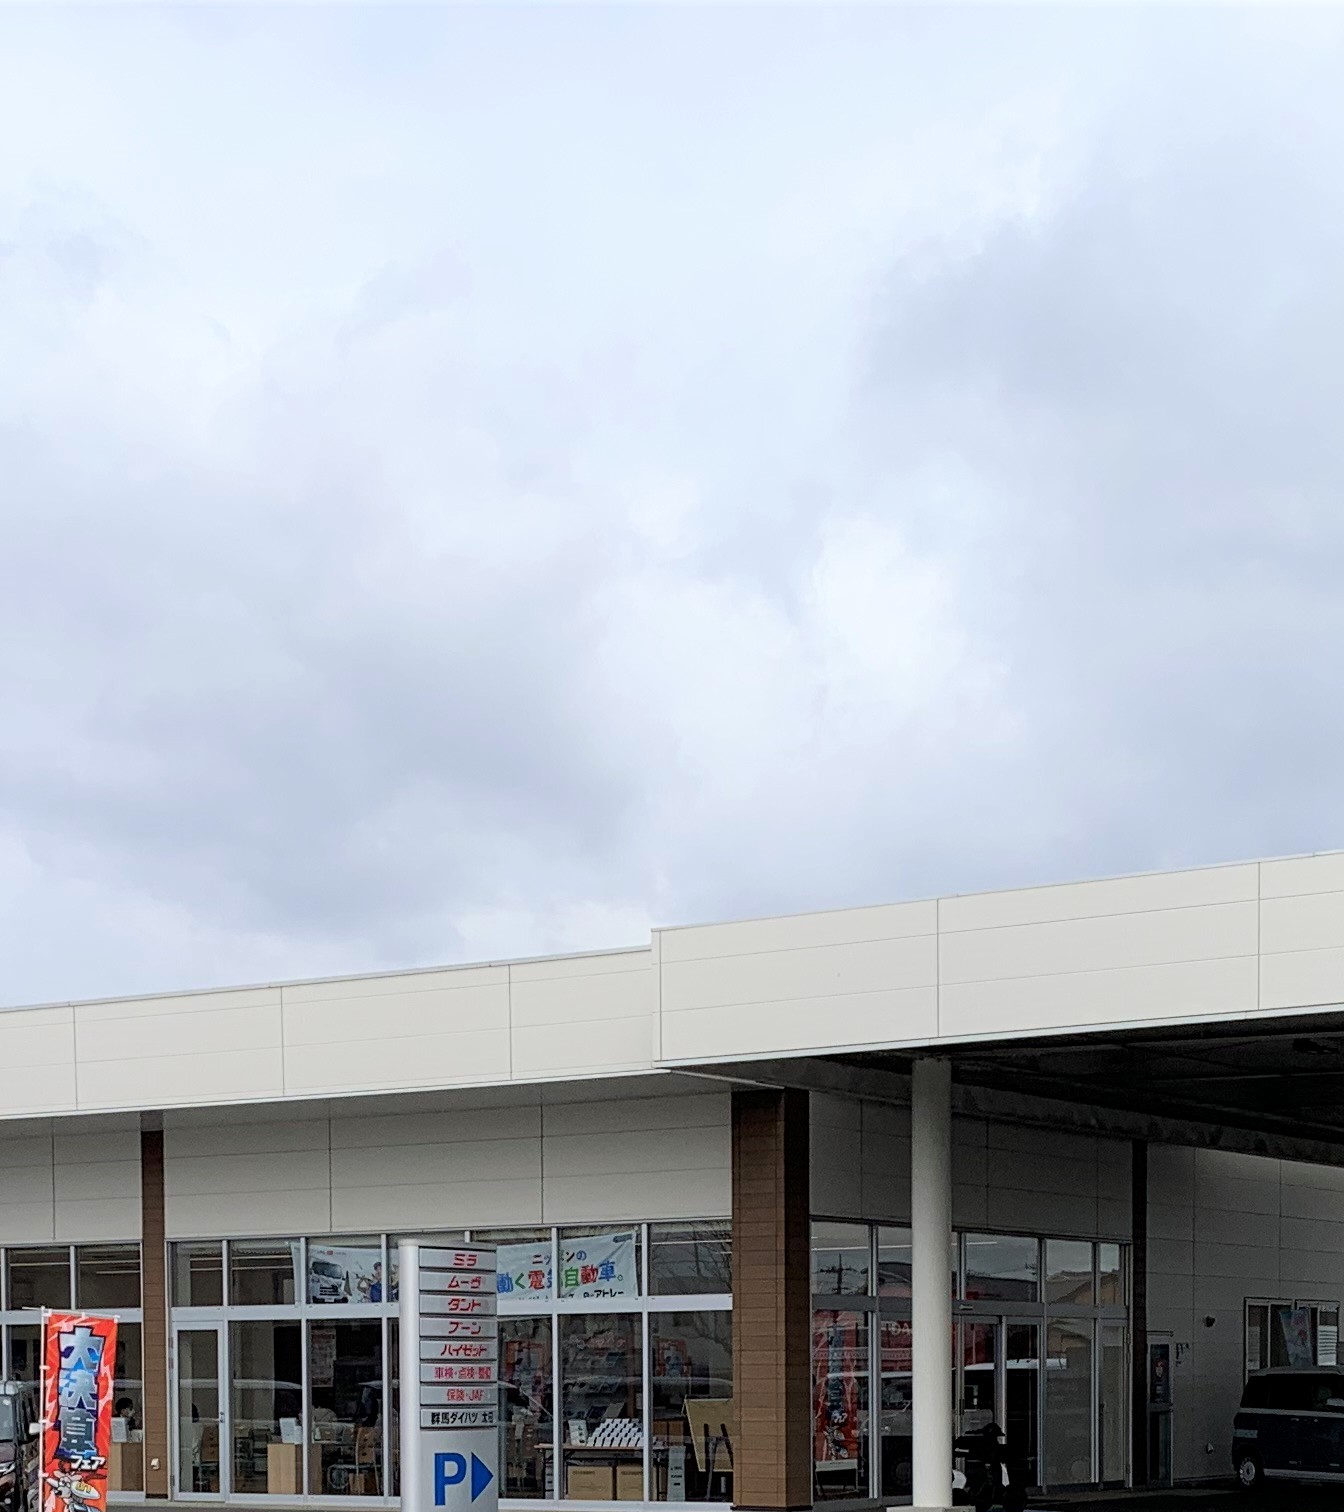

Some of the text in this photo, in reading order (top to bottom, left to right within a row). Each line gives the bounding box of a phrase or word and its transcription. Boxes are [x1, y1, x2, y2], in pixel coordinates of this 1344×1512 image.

[453, 1253, 477, 1267] ミラ
[532, 1250, 587, 1266] ニッンの
[447, 1298, 482, 1312] タント
[448, 1321, 482, 1335] ブーン
[440, 1344, 488, 1357] ハイゼット
[431, 1412, 479, 1425] 群馬ダイハツ
[70, 1455, 106, 1471] フェア
[434, 1452, 466, 1507] P
